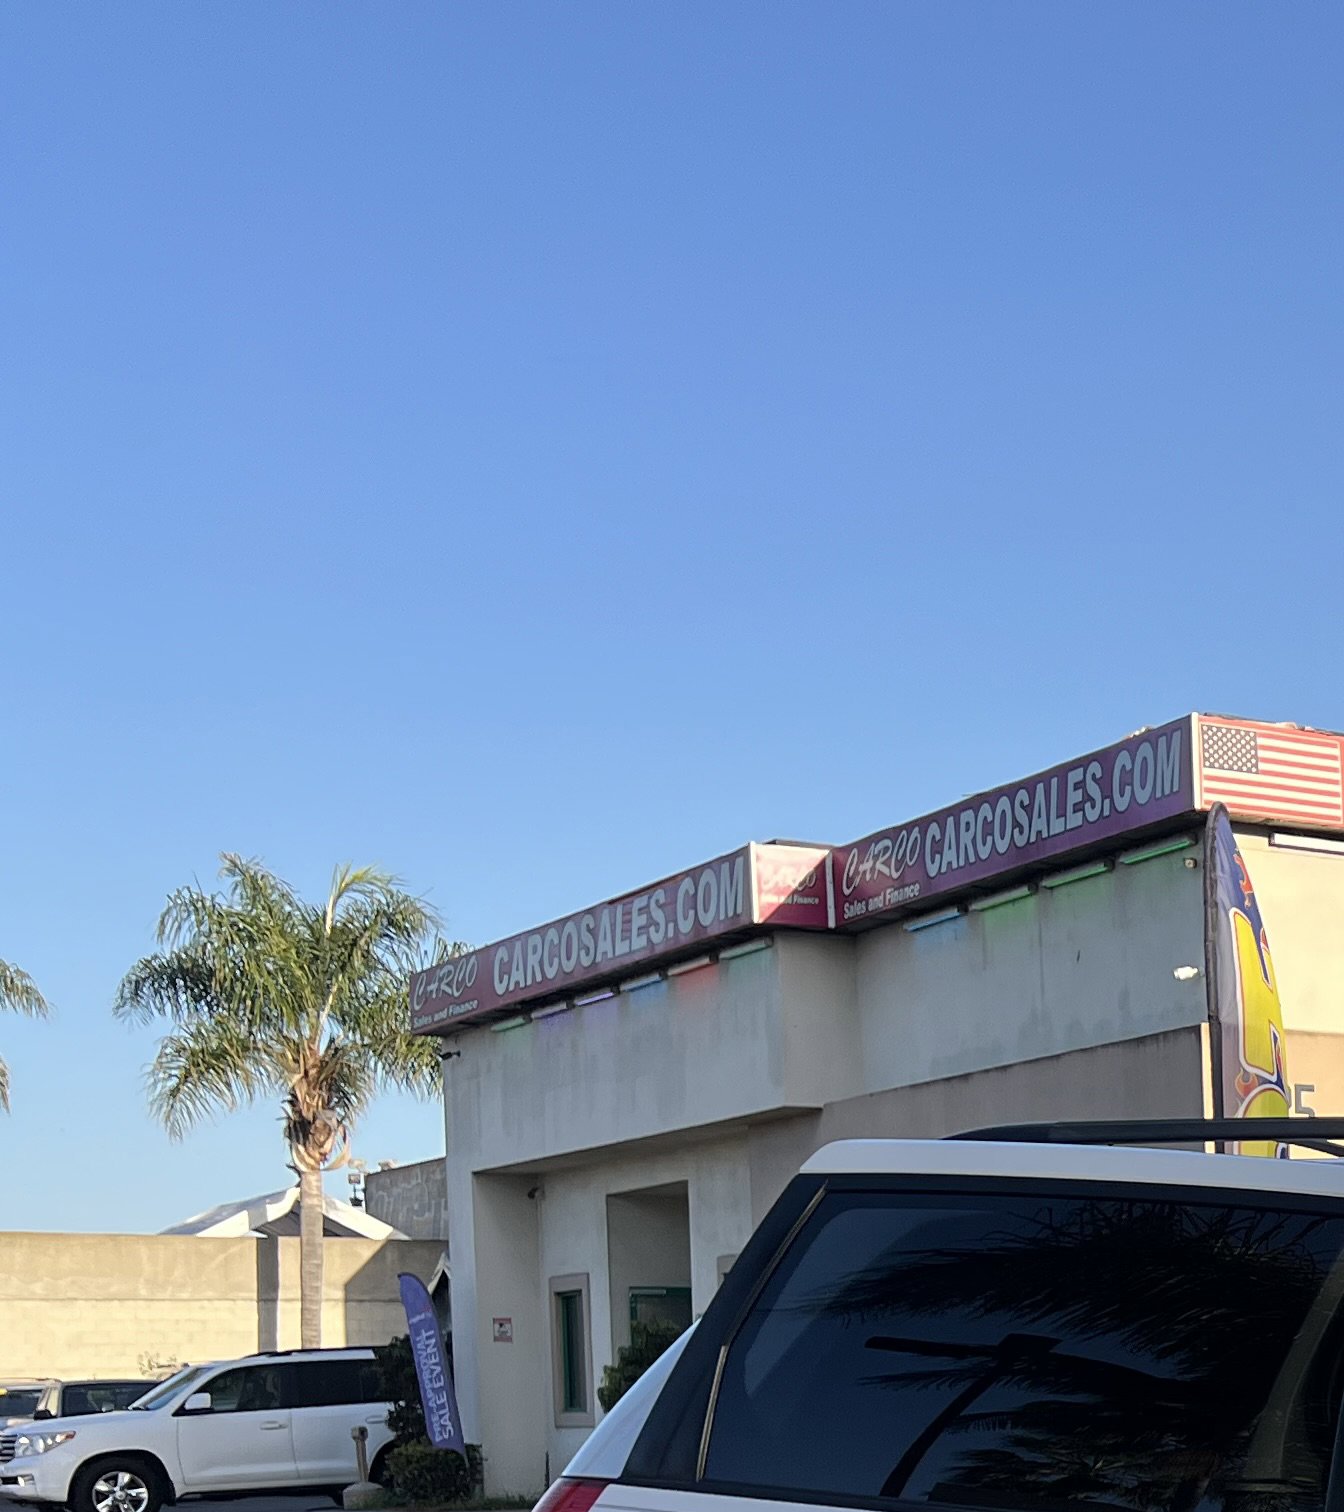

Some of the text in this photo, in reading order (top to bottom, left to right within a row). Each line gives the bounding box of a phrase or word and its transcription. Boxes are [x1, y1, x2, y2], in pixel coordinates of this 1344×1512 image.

[842, 728, 1182, 896] CARCO CARCOSALES.COM
[413, 856, 746, 1012] CARCO CARCOSALES.COM
[843, 882, 921, 920] Sales and Finance
[423, 1328, 455, 1441] SALE EVENT
